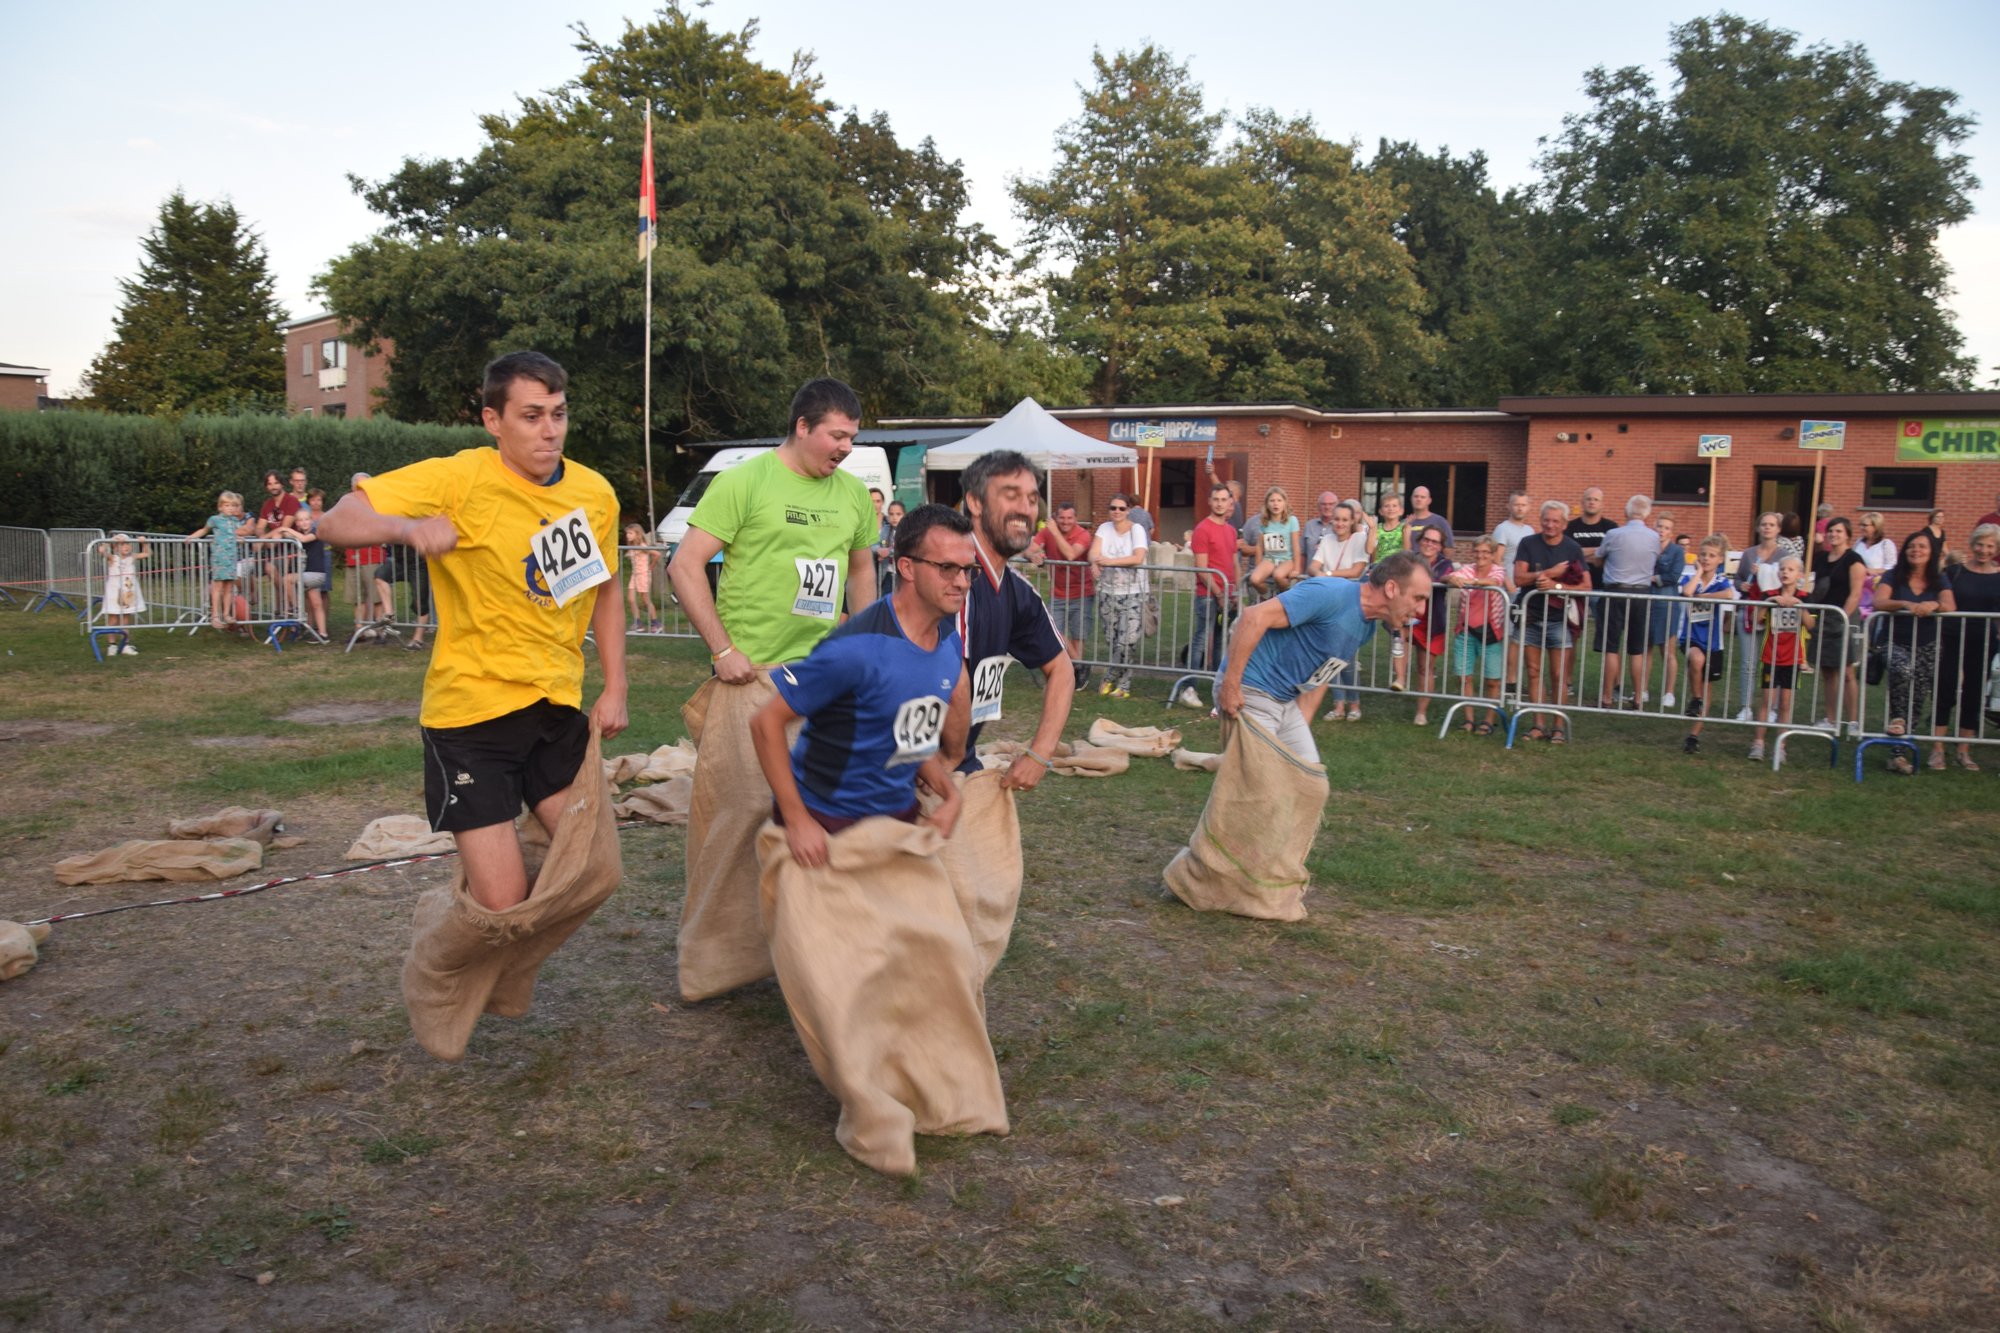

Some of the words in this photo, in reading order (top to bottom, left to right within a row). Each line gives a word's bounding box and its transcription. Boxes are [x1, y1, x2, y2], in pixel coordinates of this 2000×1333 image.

[1137, 431, 1164, 441] TOOG
[1704, 439, 1728, 452] WC
[1922, 430, 2000, 454] CHIR
[541, 517, 592, 577] 426
[802, 562, 836, 598] 427
[976, 662, 1005, 703] 428
[899, 702, 941, 749] 429
